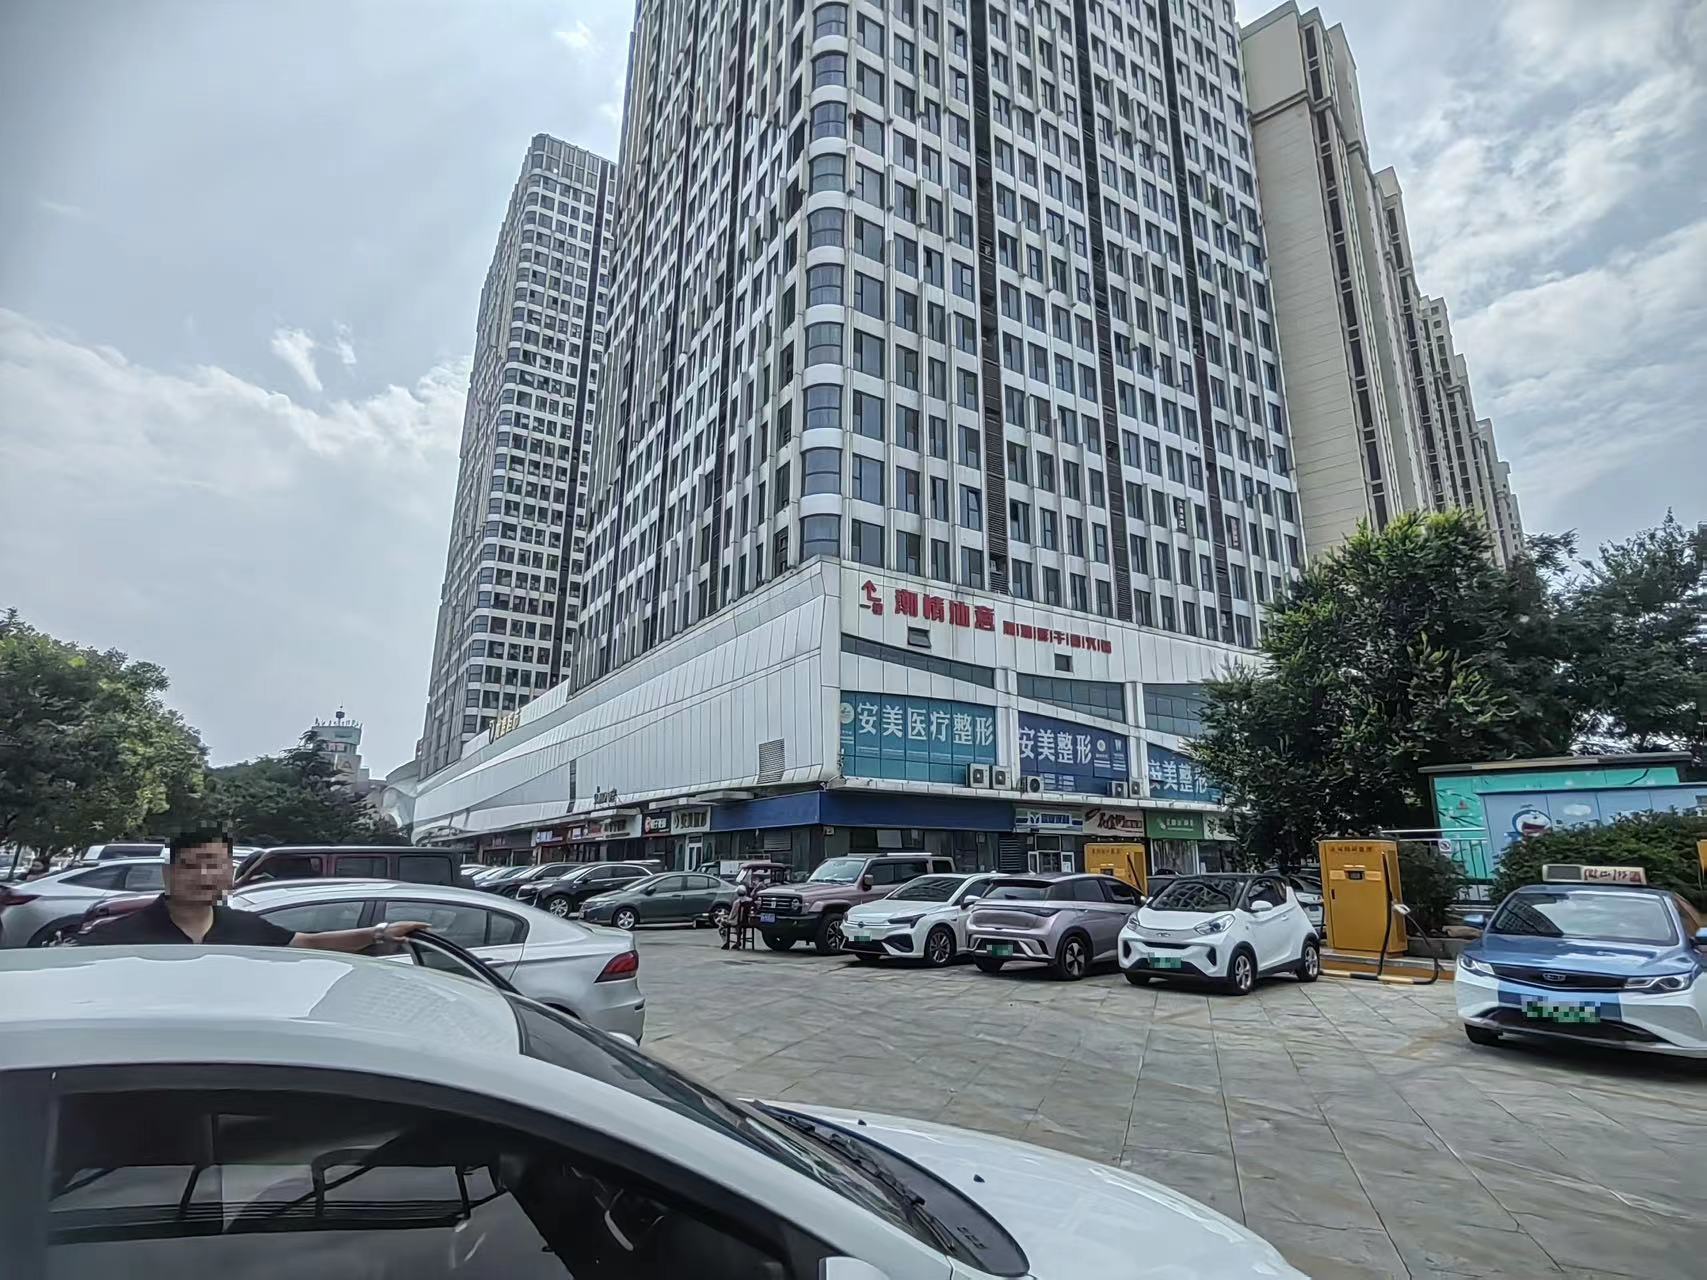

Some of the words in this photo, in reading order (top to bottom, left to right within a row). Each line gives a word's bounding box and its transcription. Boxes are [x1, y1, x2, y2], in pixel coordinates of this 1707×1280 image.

[856, 702, 994, 746] 安美医疗整形
[1019, 726, 1092, 764] 安美整形
